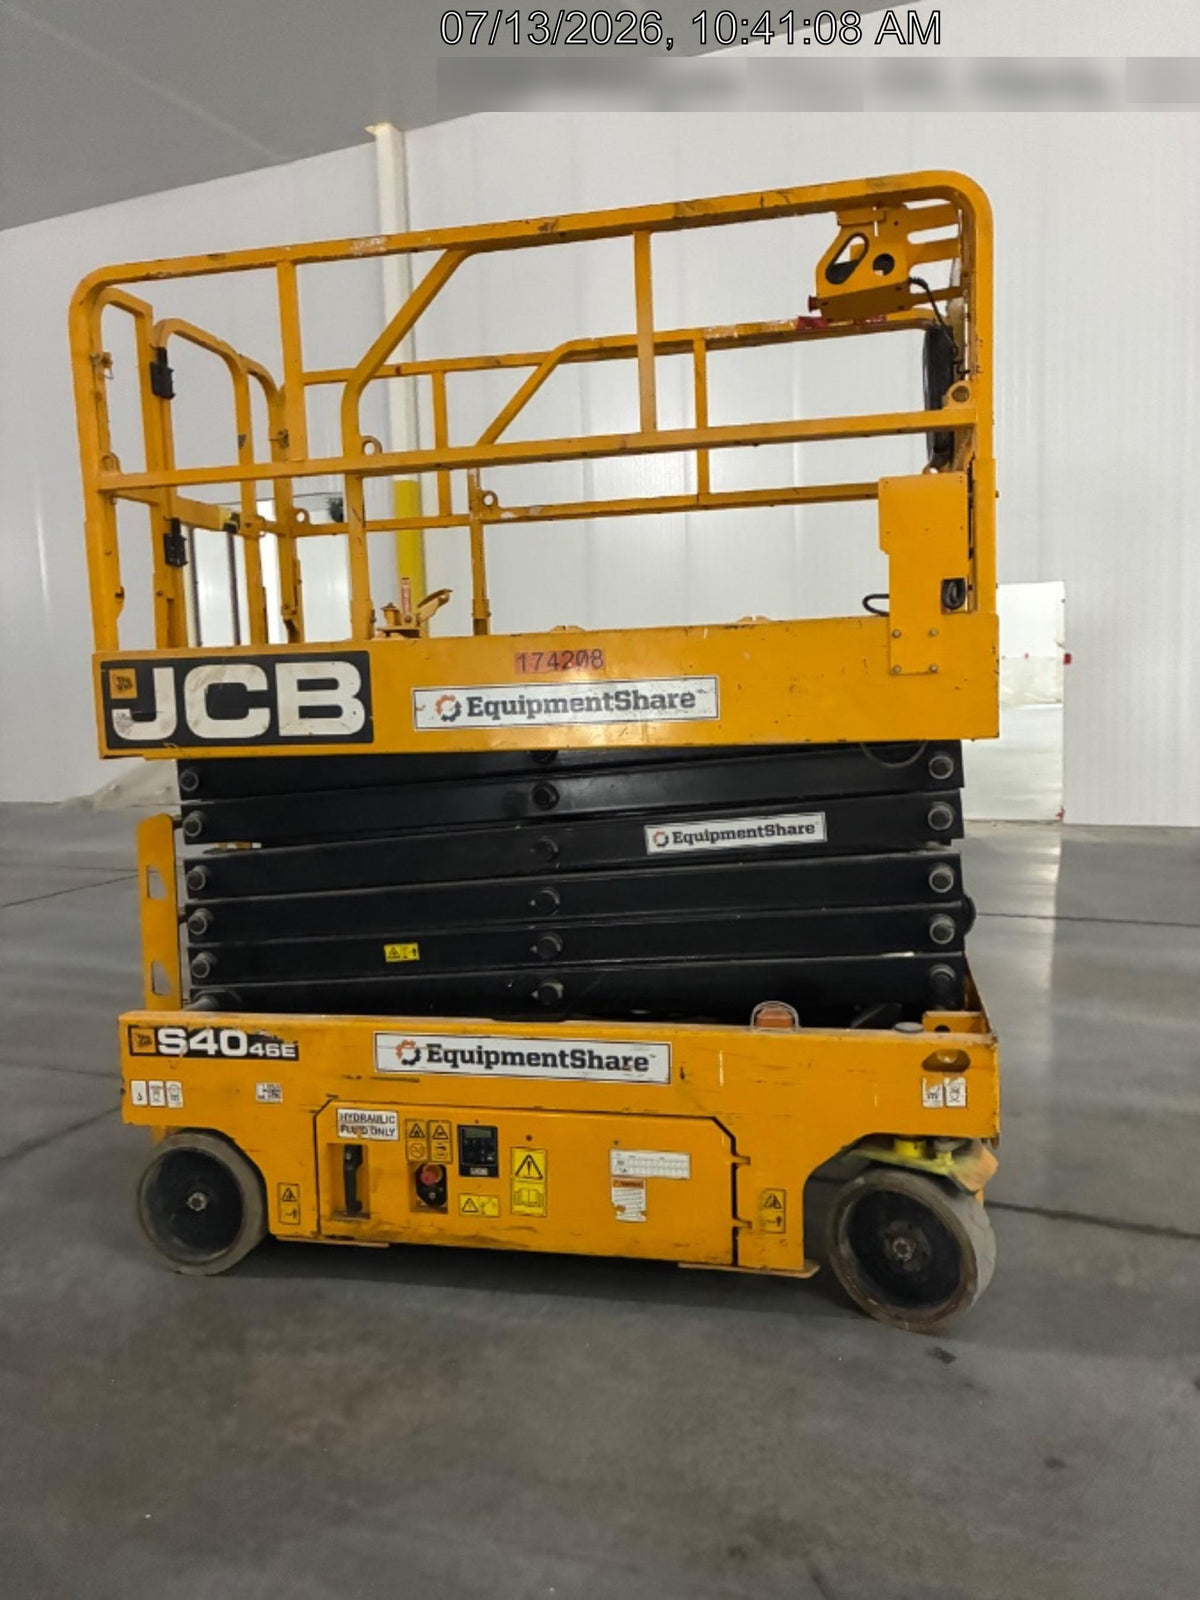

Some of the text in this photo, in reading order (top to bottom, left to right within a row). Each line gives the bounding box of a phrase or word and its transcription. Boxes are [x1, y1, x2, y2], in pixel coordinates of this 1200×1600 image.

[111, 661, 366, 740] JCB
[466, 689, 696, 718] EquipmentShare
[672, 823, 816, 845] EquipmentShare
[426, 1043, 649, 1071] EquipmentShare
[340, 1112, 395, 1124] HYDRAULIC
